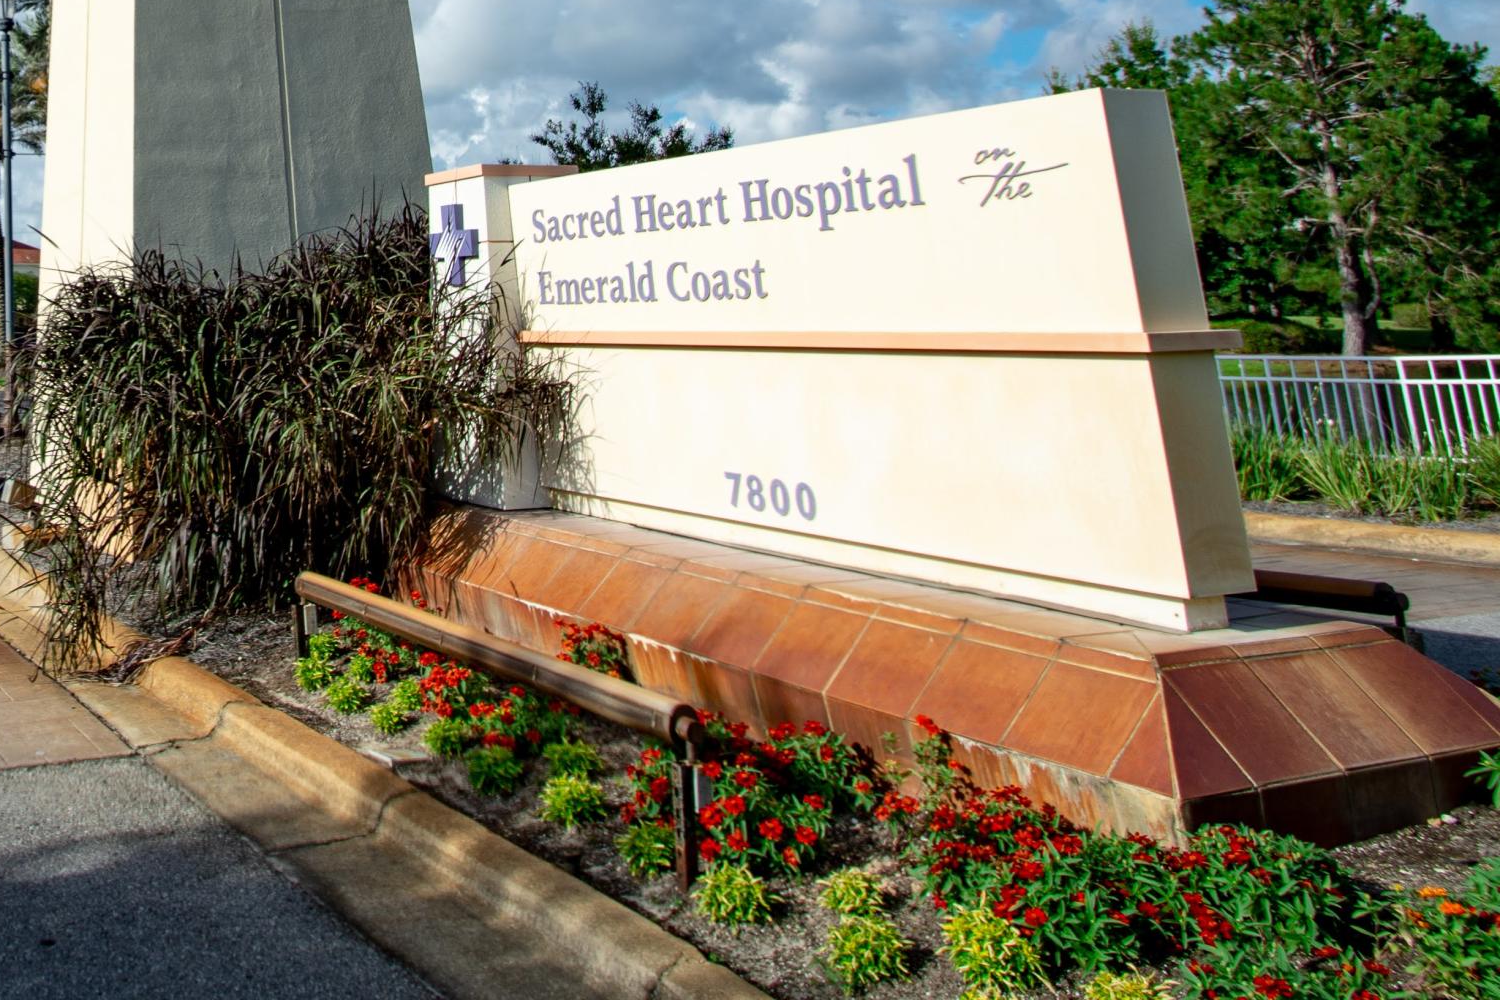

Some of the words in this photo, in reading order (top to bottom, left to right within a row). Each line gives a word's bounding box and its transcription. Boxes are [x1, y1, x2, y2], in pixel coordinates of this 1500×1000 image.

[976, 148, 1016, 165] on
[532, 195, 625, 243] Sacred
[631, 187, 730, 233] Heart
[738, 154, 926, 231] Hospital
[958, 161, 1069, 207] The
[538, 260, 658, 306] Emerald
[666, 259, 768, 303] Coast
[724, 472, 817, 521] 7800
